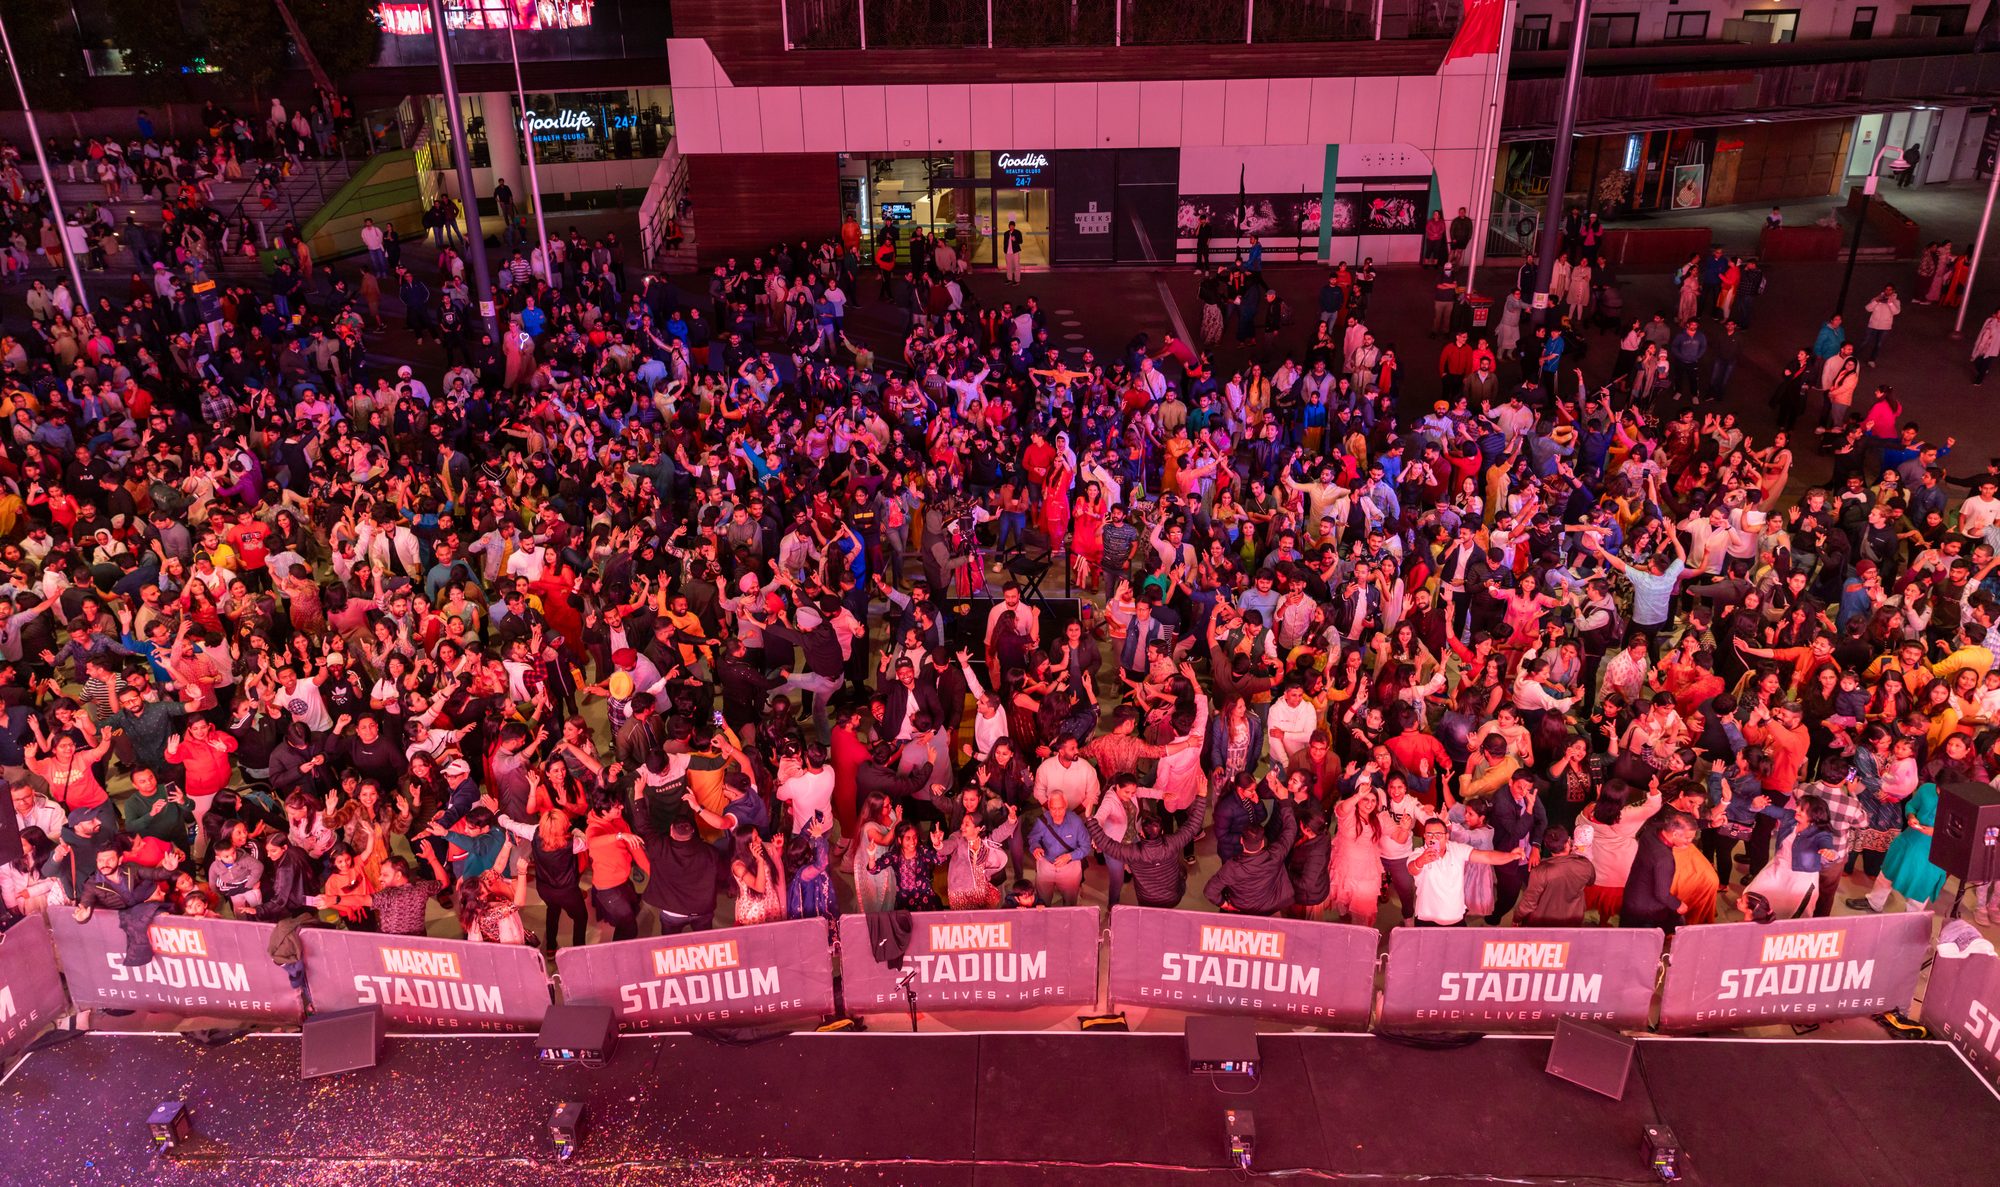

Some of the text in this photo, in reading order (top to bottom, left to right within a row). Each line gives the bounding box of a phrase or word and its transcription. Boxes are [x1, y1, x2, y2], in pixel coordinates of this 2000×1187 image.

[533, 132, 586, 142] HEALTH CLUBS
[150, 926, 206, 955] ARVEL
[931, 924, 1009, 950] MARVEL
[1202, 927, 1281, 957] MARVEL
[1762, 932, 1839, 962] MARVEL
[382, 949, 460, 978] MARVEL
[654, 943, 737, 975] MARVEL
[1482, 943, 1564, 968] MARVEL
[1161, 952, 1320, 996] STADIUM
[1438, 972, 1603, 1003] STADIUM
[1717, 959, 1875, 1000] STADIUM
[98, 988, 272, 1011] EPIC LIVES HERE
[353, 975, 504, 1014] STADIUM
[620, 966, 780, 1014] STADIUM
[942, 990, 996, 1000] LIVES
[1020, 986, 1065, 1000] HERE
[1141, 986, 1336, 1017] EPIC LIVES HERE
[406, 1014, 526, 1032] LIVES HERE
[618, 998, 802, 1031] PIC LIVES HERE
[1416, 1009, 1461, 1019] EPIC
[1484, 1010, 1542, 1020] LIVES
[1696, 997, 1886, 1021] EPIC LIVES HERE
[1943, 1022, 1977, 1061] EPIC
